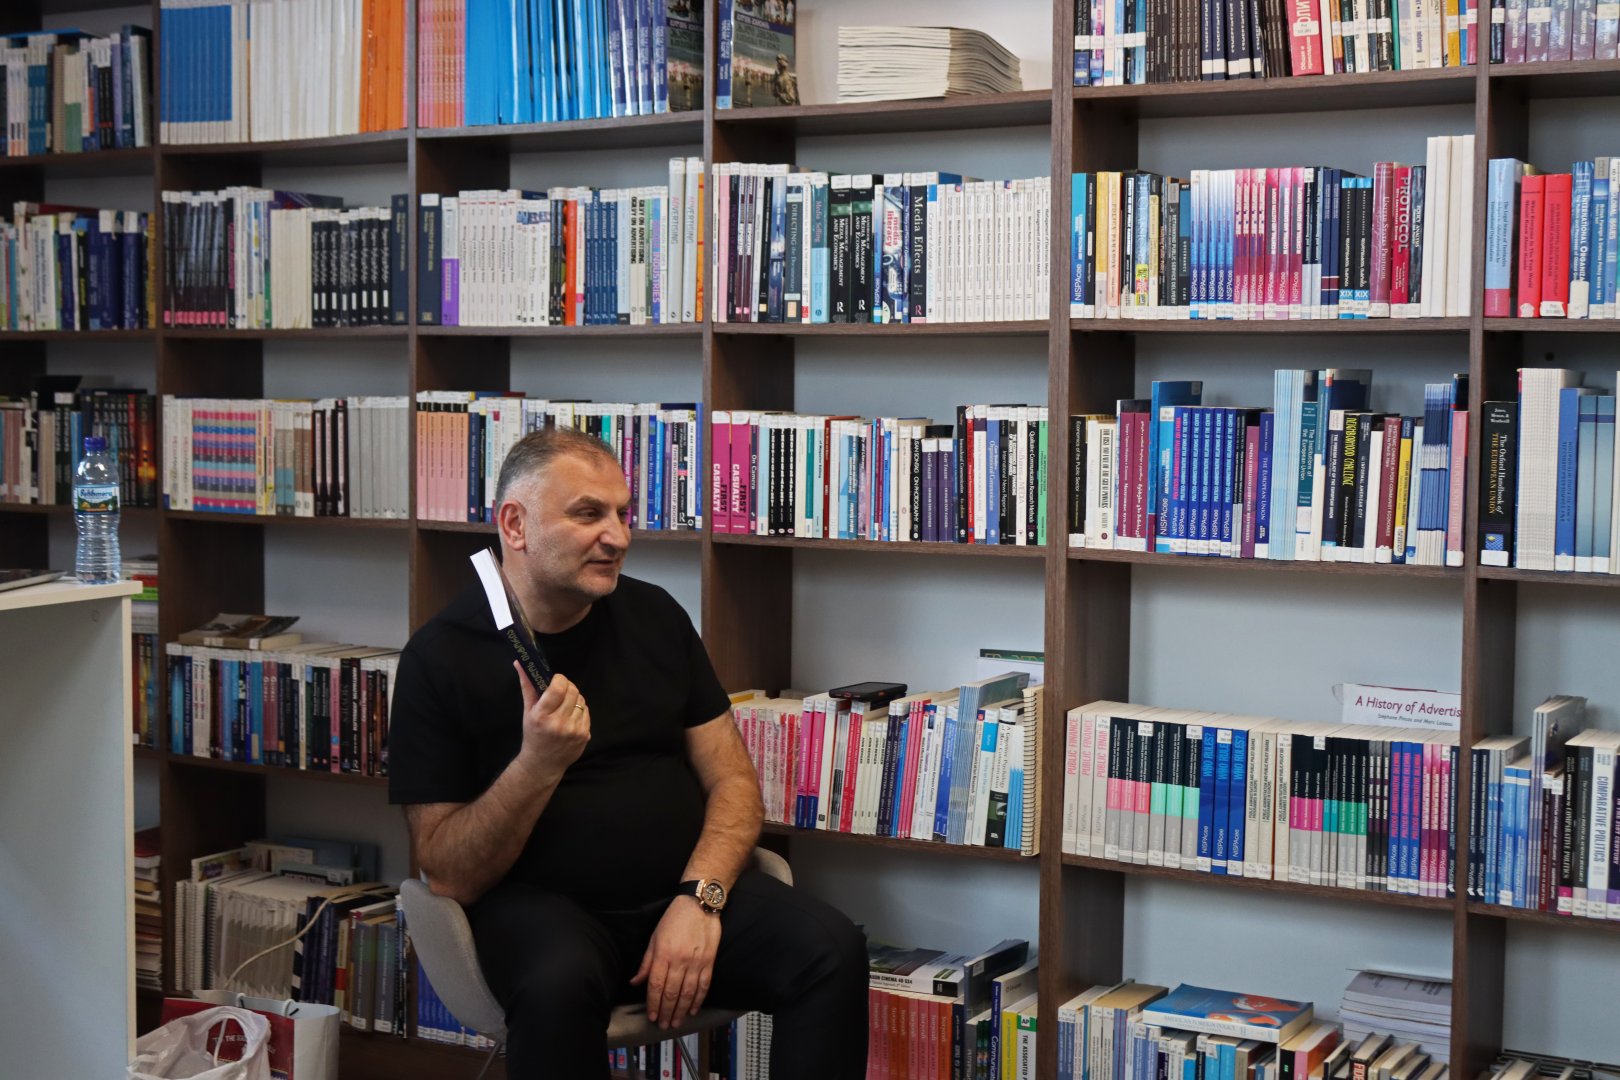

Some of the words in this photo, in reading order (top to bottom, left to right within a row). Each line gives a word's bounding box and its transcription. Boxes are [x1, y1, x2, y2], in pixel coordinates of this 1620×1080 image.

[671, 197, 679, 244] ADVERTISING
[686, 196, 694, 244] ADVERTISING
[914, 196, 923, 232] Media
[1398, 177, 1411, 253] PROTOCOL
[1580, 195, 1590, 244] INTERNATIONAL
[814, 222, 822, 243] Selling
[885, 211, 894, 247] literacy
[892, 217, 900, 246] media
[914, 236, 923, 274] Effects
[1074, 264, 1082, 301] NISPAcee
[1499, 435, 1507, 447] The
[751, 455, 757, 463] On
[1490, 449, 1498, 489] EUROPEAN
[1498, 449, 1506, 471] Oxford
[1497, 472, 1506, 505] Handbook
[1488, 491, 1496, 514] UNION
[1160, 498, 1168, 535] NISPAcee
[1355, 695, 1363, 706] A
[1366, 696, 1403, 714] History
[1404, 701, 1418, 714] of
[1418, 702, 1461, 717] Advertis
[1068, 718, 1078, 748] FINANCE
[1083, 718, 1093, 748] FINANCE
[1097, 731, 1107, 751] FINAN
[1203, 732, 1214, 759] RULES?
[1218, 744, 1229, 762] RULE
[1234, 735, 1244, 762] RULES?
[1067, 750, 1077, 775] PUBLIC
[1082, 750, 1092, 775] PUBLIC
[1097, 753, 1106, 778] PUBLIC
[1202, 760, 1213, 777] WHO
[1218, 762, 1228, 780] WHO
[1234, 763, 1244, 780] WHO
[1594, 776, 1608, 827] COMPARATIVE
[1593, 829, 1607, 862] POLITICS
[1353, 1062, 1366, 1080] FIDE
